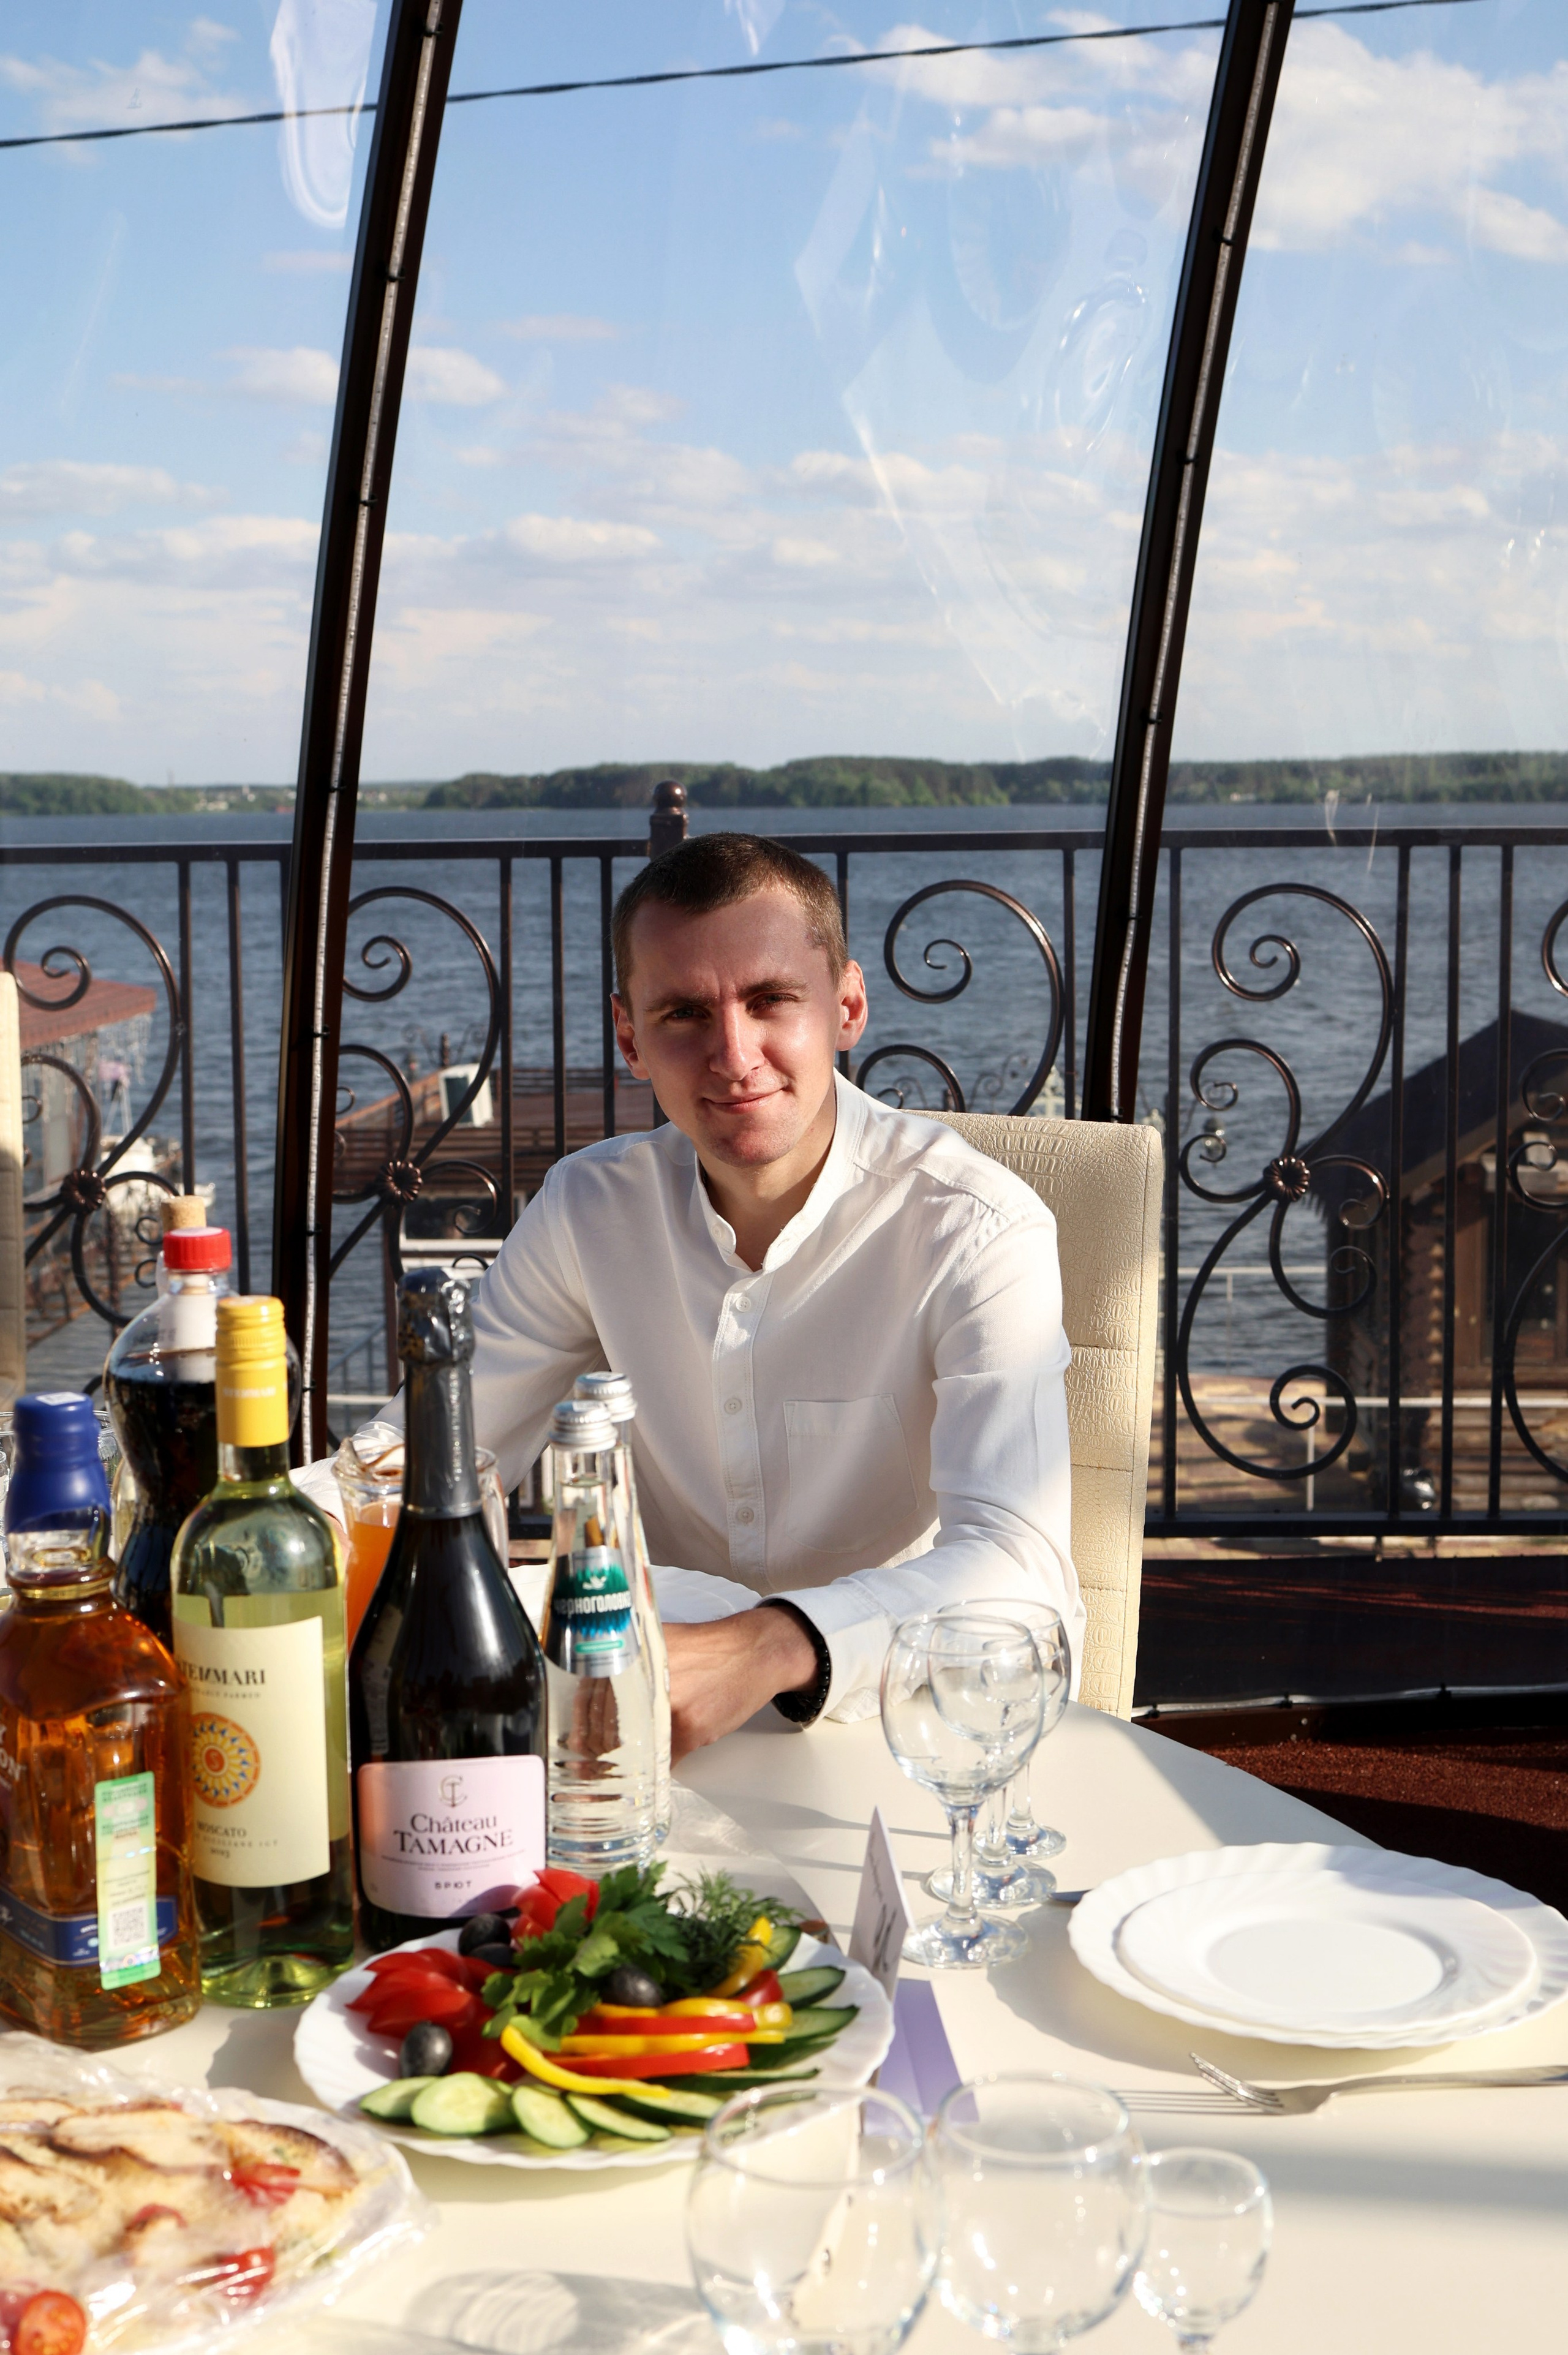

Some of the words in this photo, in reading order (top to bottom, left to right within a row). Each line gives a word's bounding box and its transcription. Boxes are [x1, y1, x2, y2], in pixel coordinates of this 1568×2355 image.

[176, 1657, 266, 1685] TEMMARI
[411, 1814, 497, 1833] Château
[393, 1829, 513, 1855] TAMAGNE
